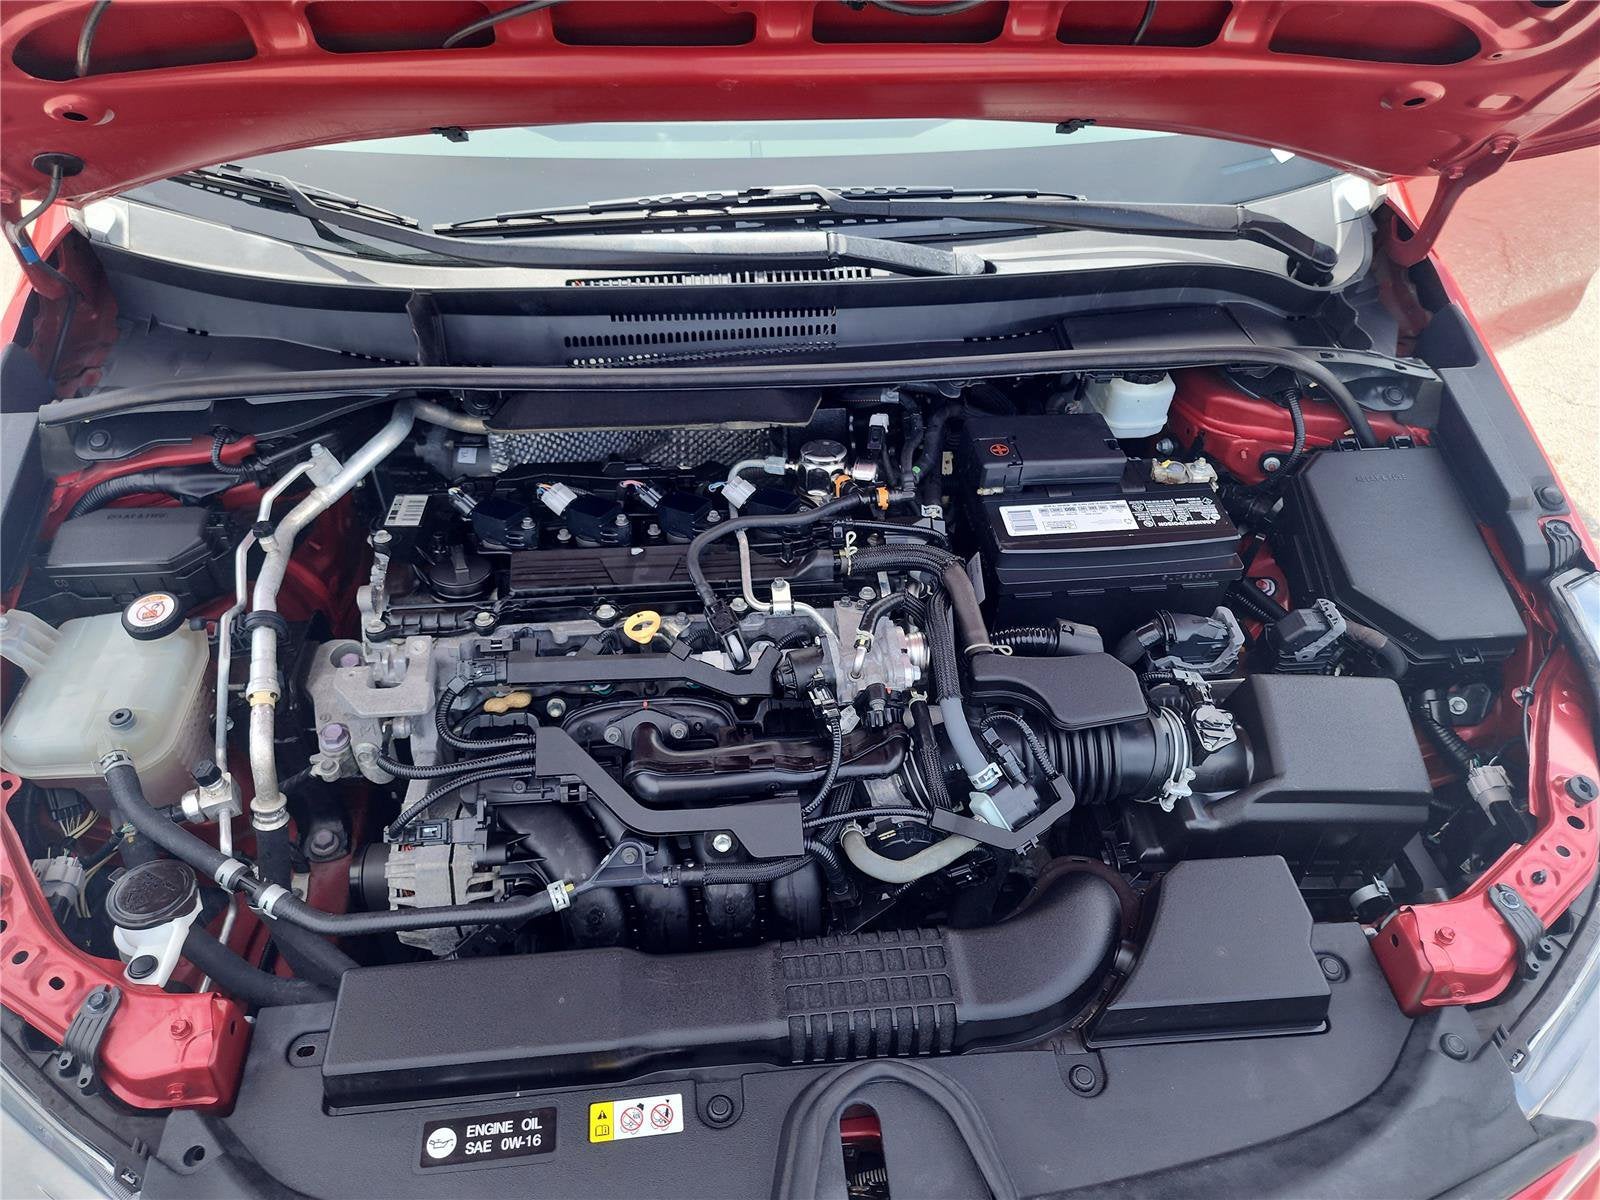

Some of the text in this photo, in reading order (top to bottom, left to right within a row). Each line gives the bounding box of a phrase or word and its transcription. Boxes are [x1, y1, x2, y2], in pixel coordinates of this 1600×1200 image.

[466, 1117, 542, 1138] ENGINE OIL
[465, 1133, 541, 1155] SAE 0W-16
